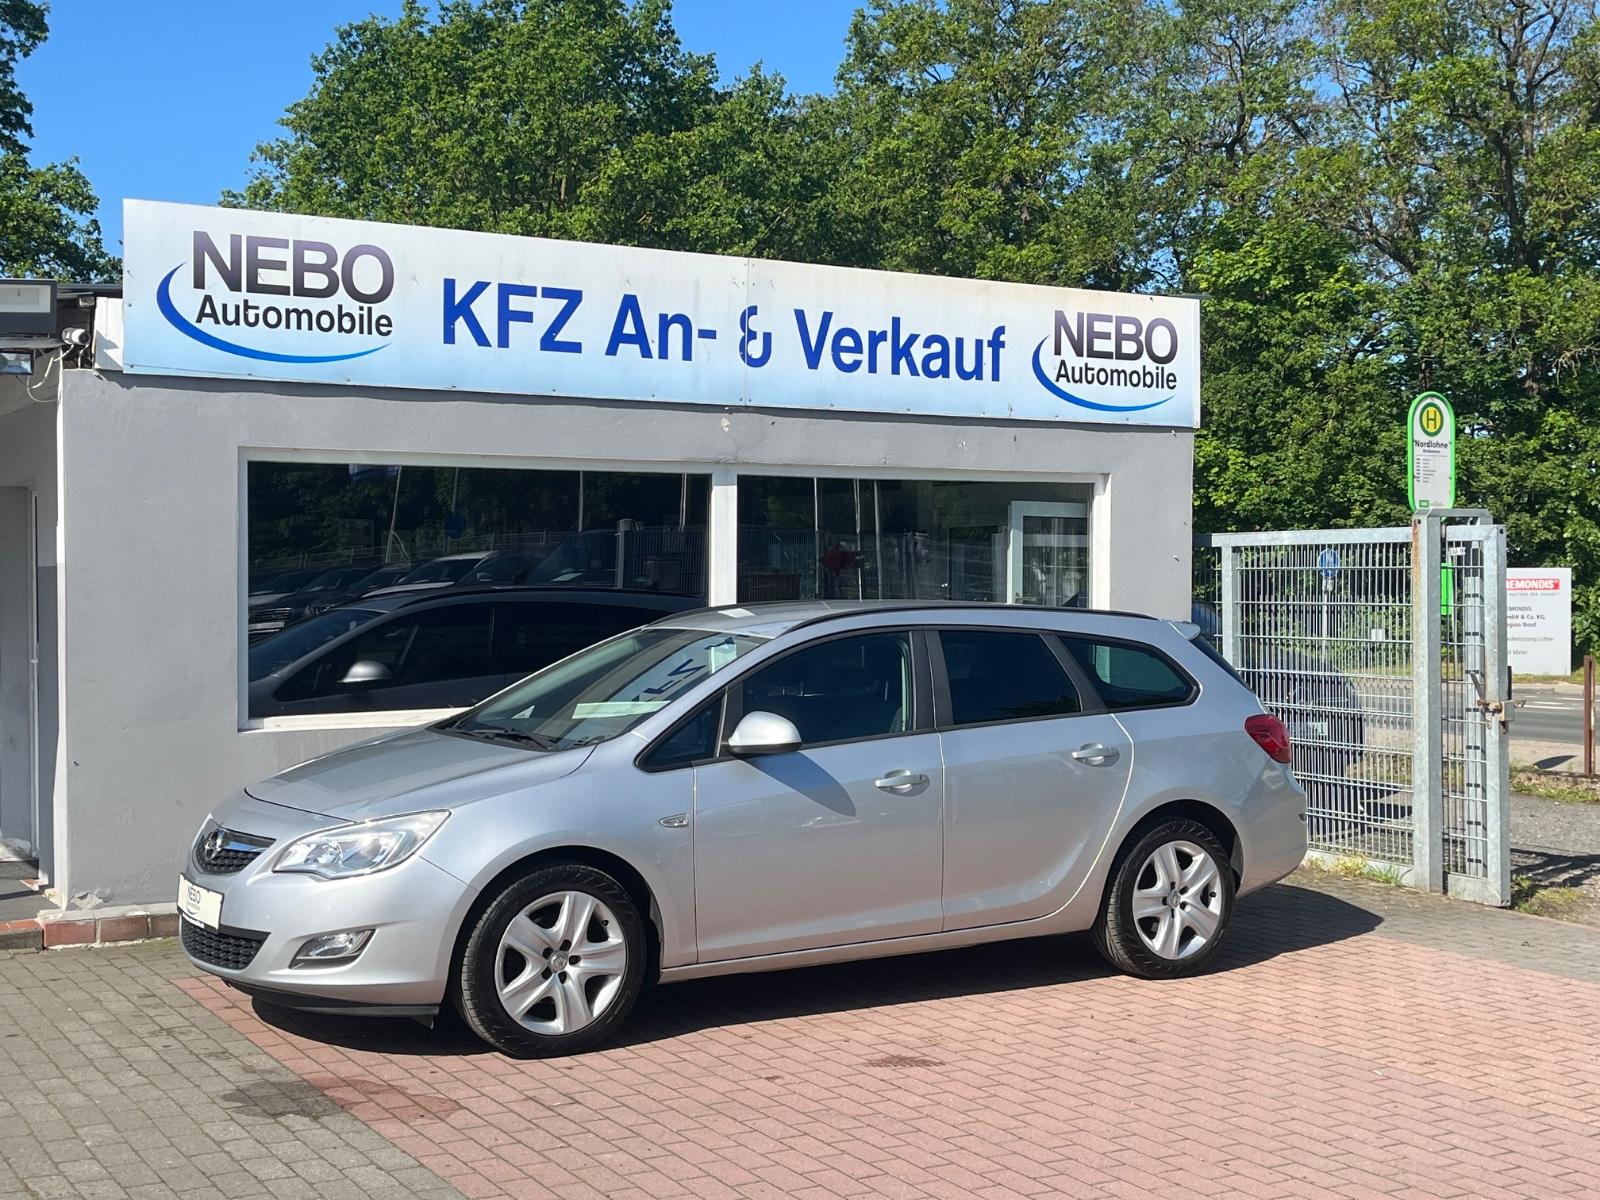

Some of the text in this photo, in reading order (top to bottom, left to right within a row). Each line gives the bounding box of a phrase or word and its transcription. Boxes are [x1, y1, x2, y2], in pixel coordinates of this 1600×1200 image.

[192, 230, 395, 304] NEBO
[195, 294, 393, 337] Automobile
[443, 277, 1006, 382] KFZ An- & Verkauf
[1053, 310, 1178, 365] NEBO
[1055, 359, 1177, 390] Automobile
[1426, 410, 1436, 429] H
[1415, 439, 1448, 449] Nordlohne
